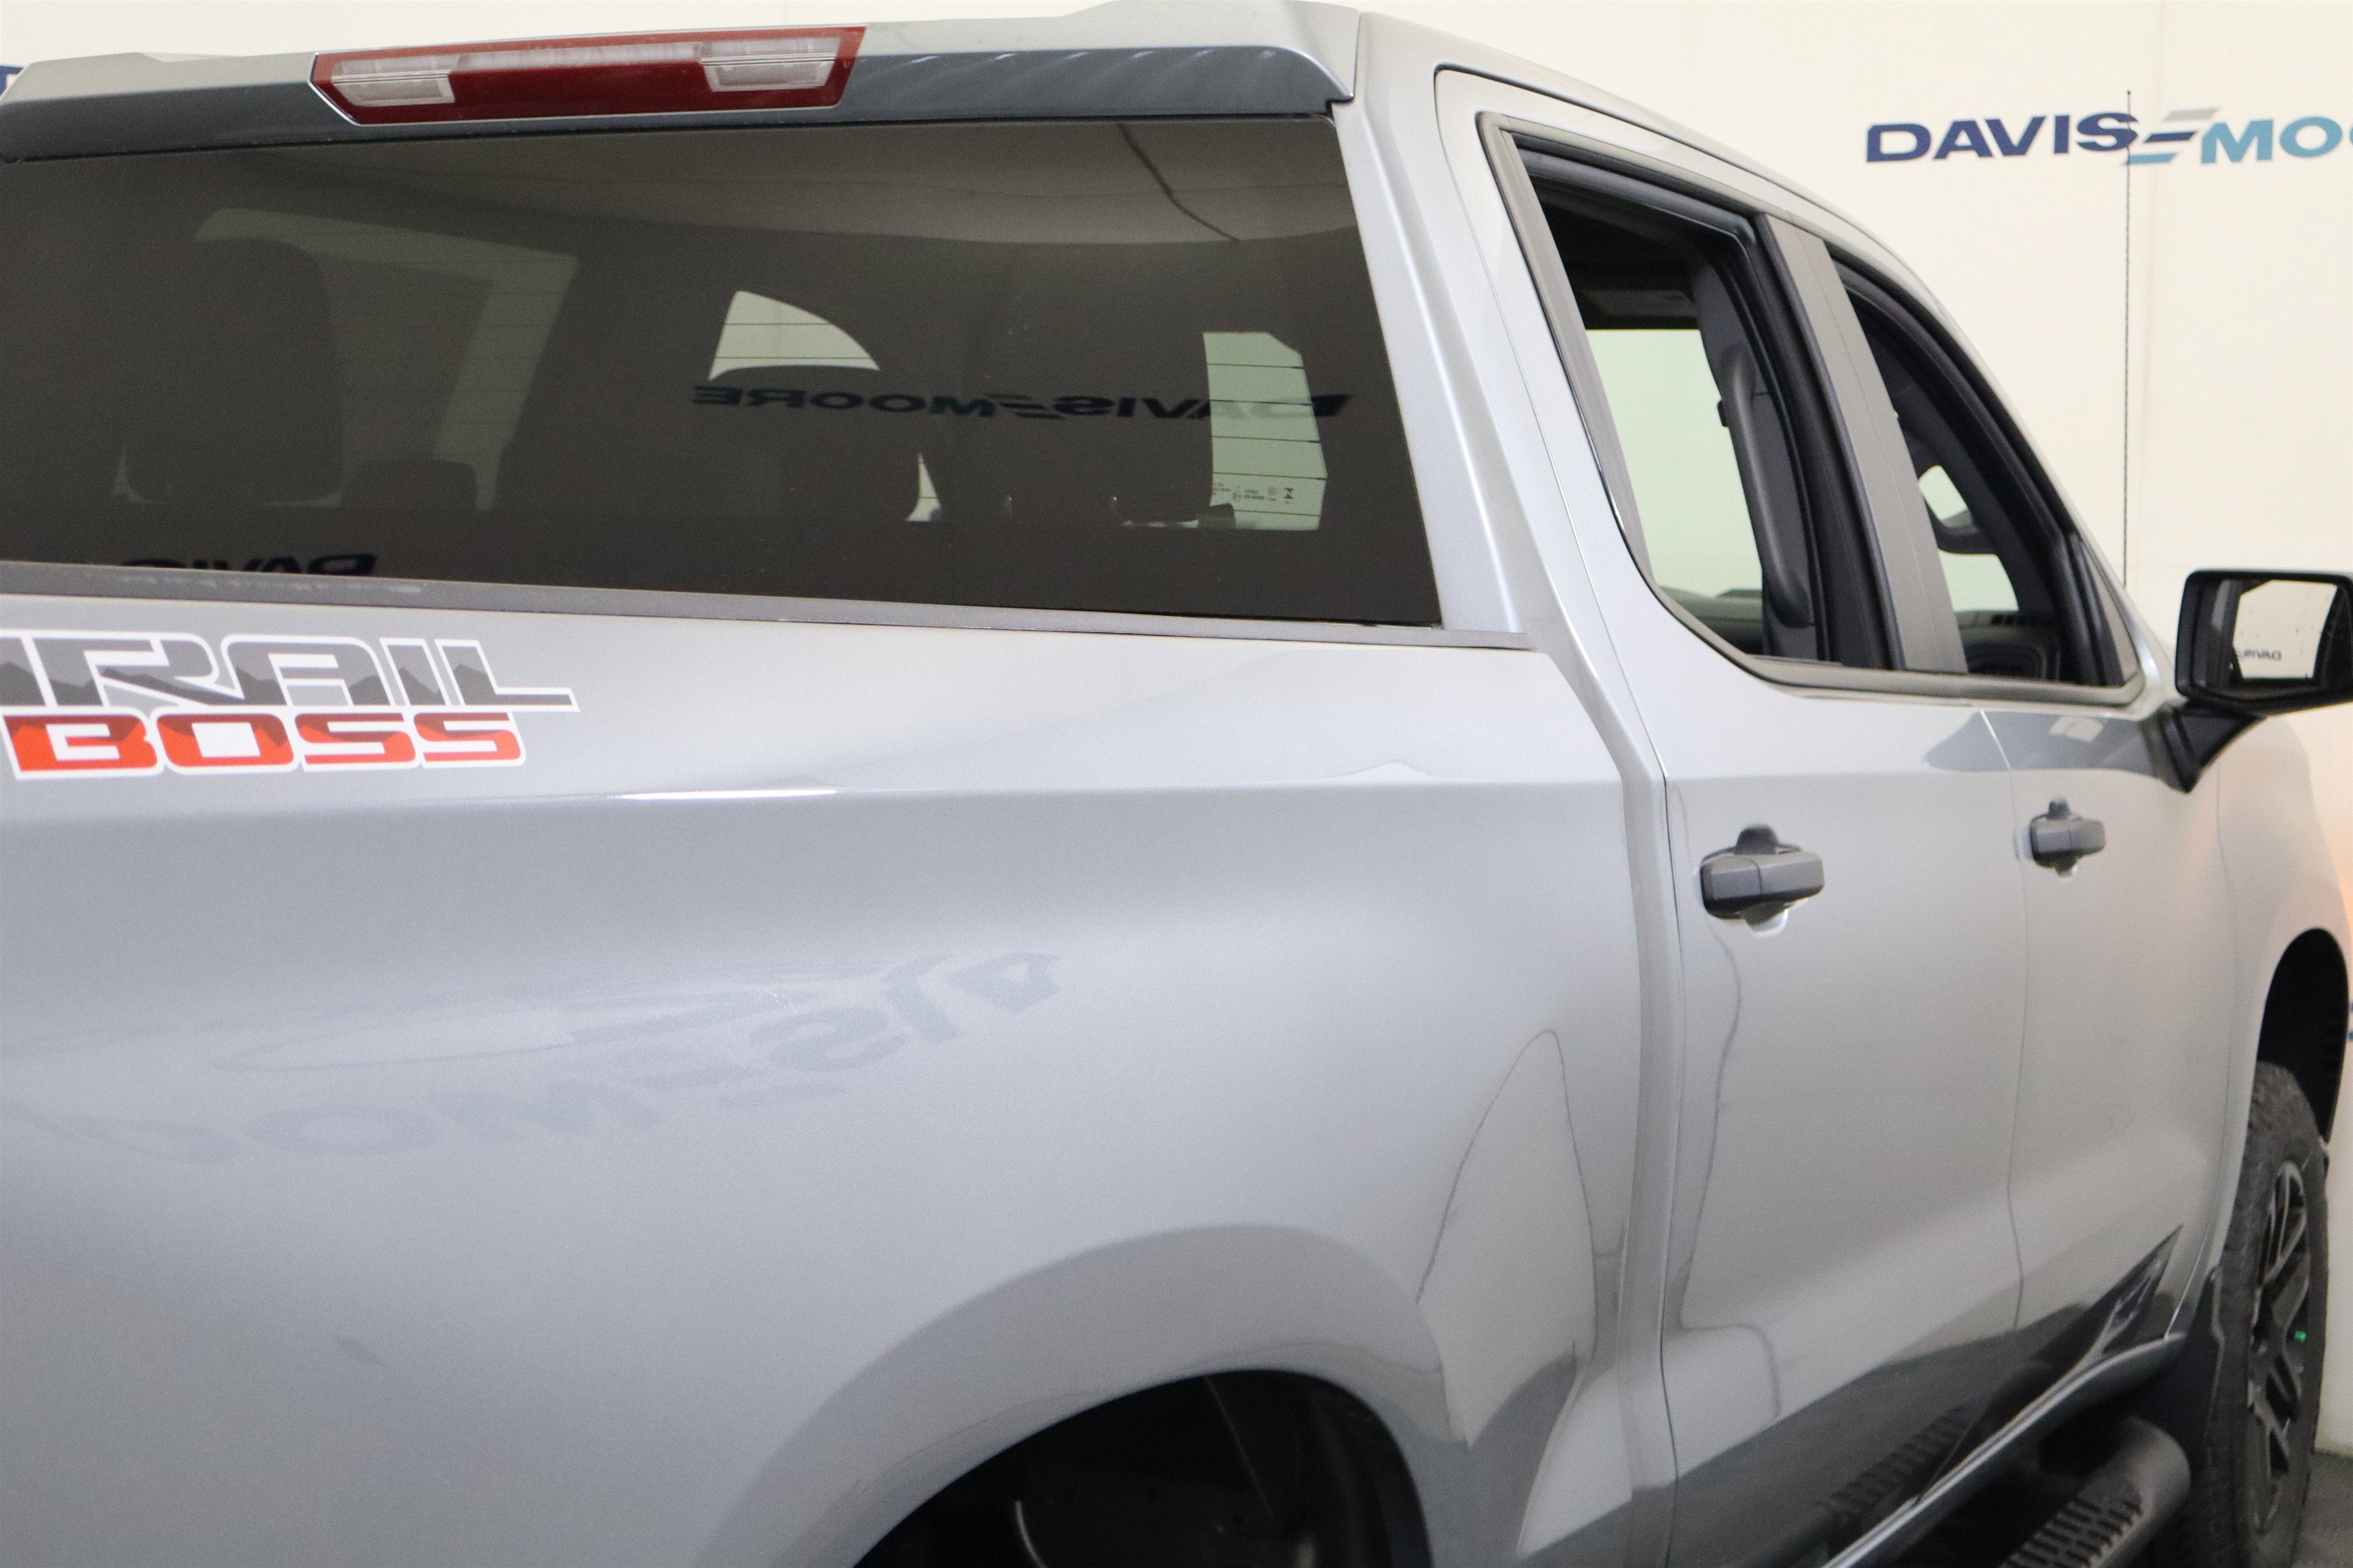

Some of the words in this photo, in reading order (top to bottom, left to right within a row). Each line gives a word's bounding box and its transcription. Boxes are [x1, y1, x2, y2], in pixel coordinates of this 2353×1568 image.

[1866, 112, 2139, 163] DAVIS
[2201, 116, 2353, 164] MO
[2, 711, 526, 779] BOSS
